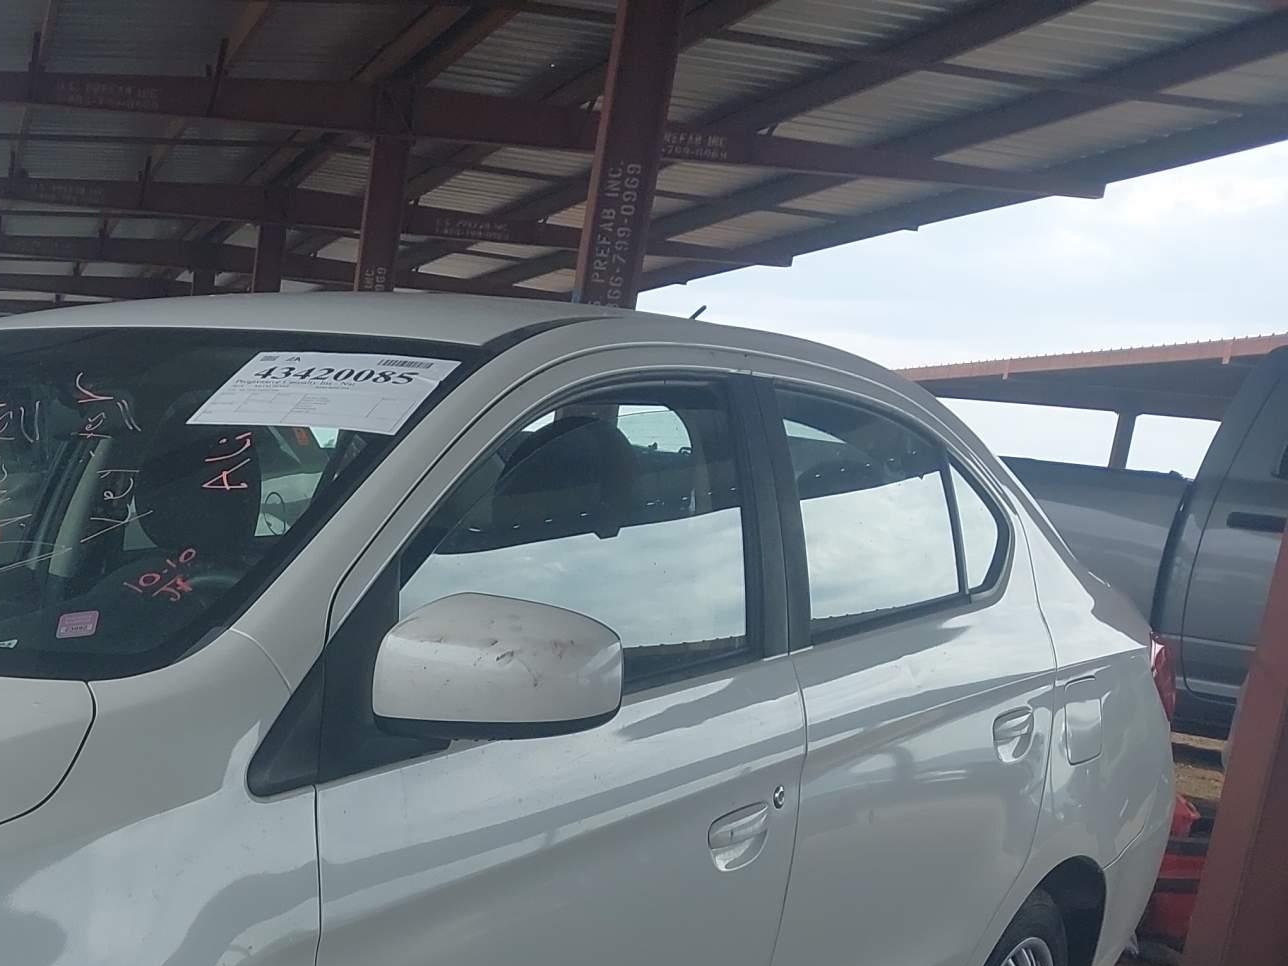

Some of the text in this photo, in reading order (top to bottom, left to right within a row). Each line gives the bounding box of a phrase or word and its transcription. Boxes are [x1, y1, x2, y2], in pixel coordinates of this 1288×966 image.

[592, 207, 616, 283] PREFAB
[605, 160, 625, 197] INC.
[253, 365, 419, 385] 43420085
